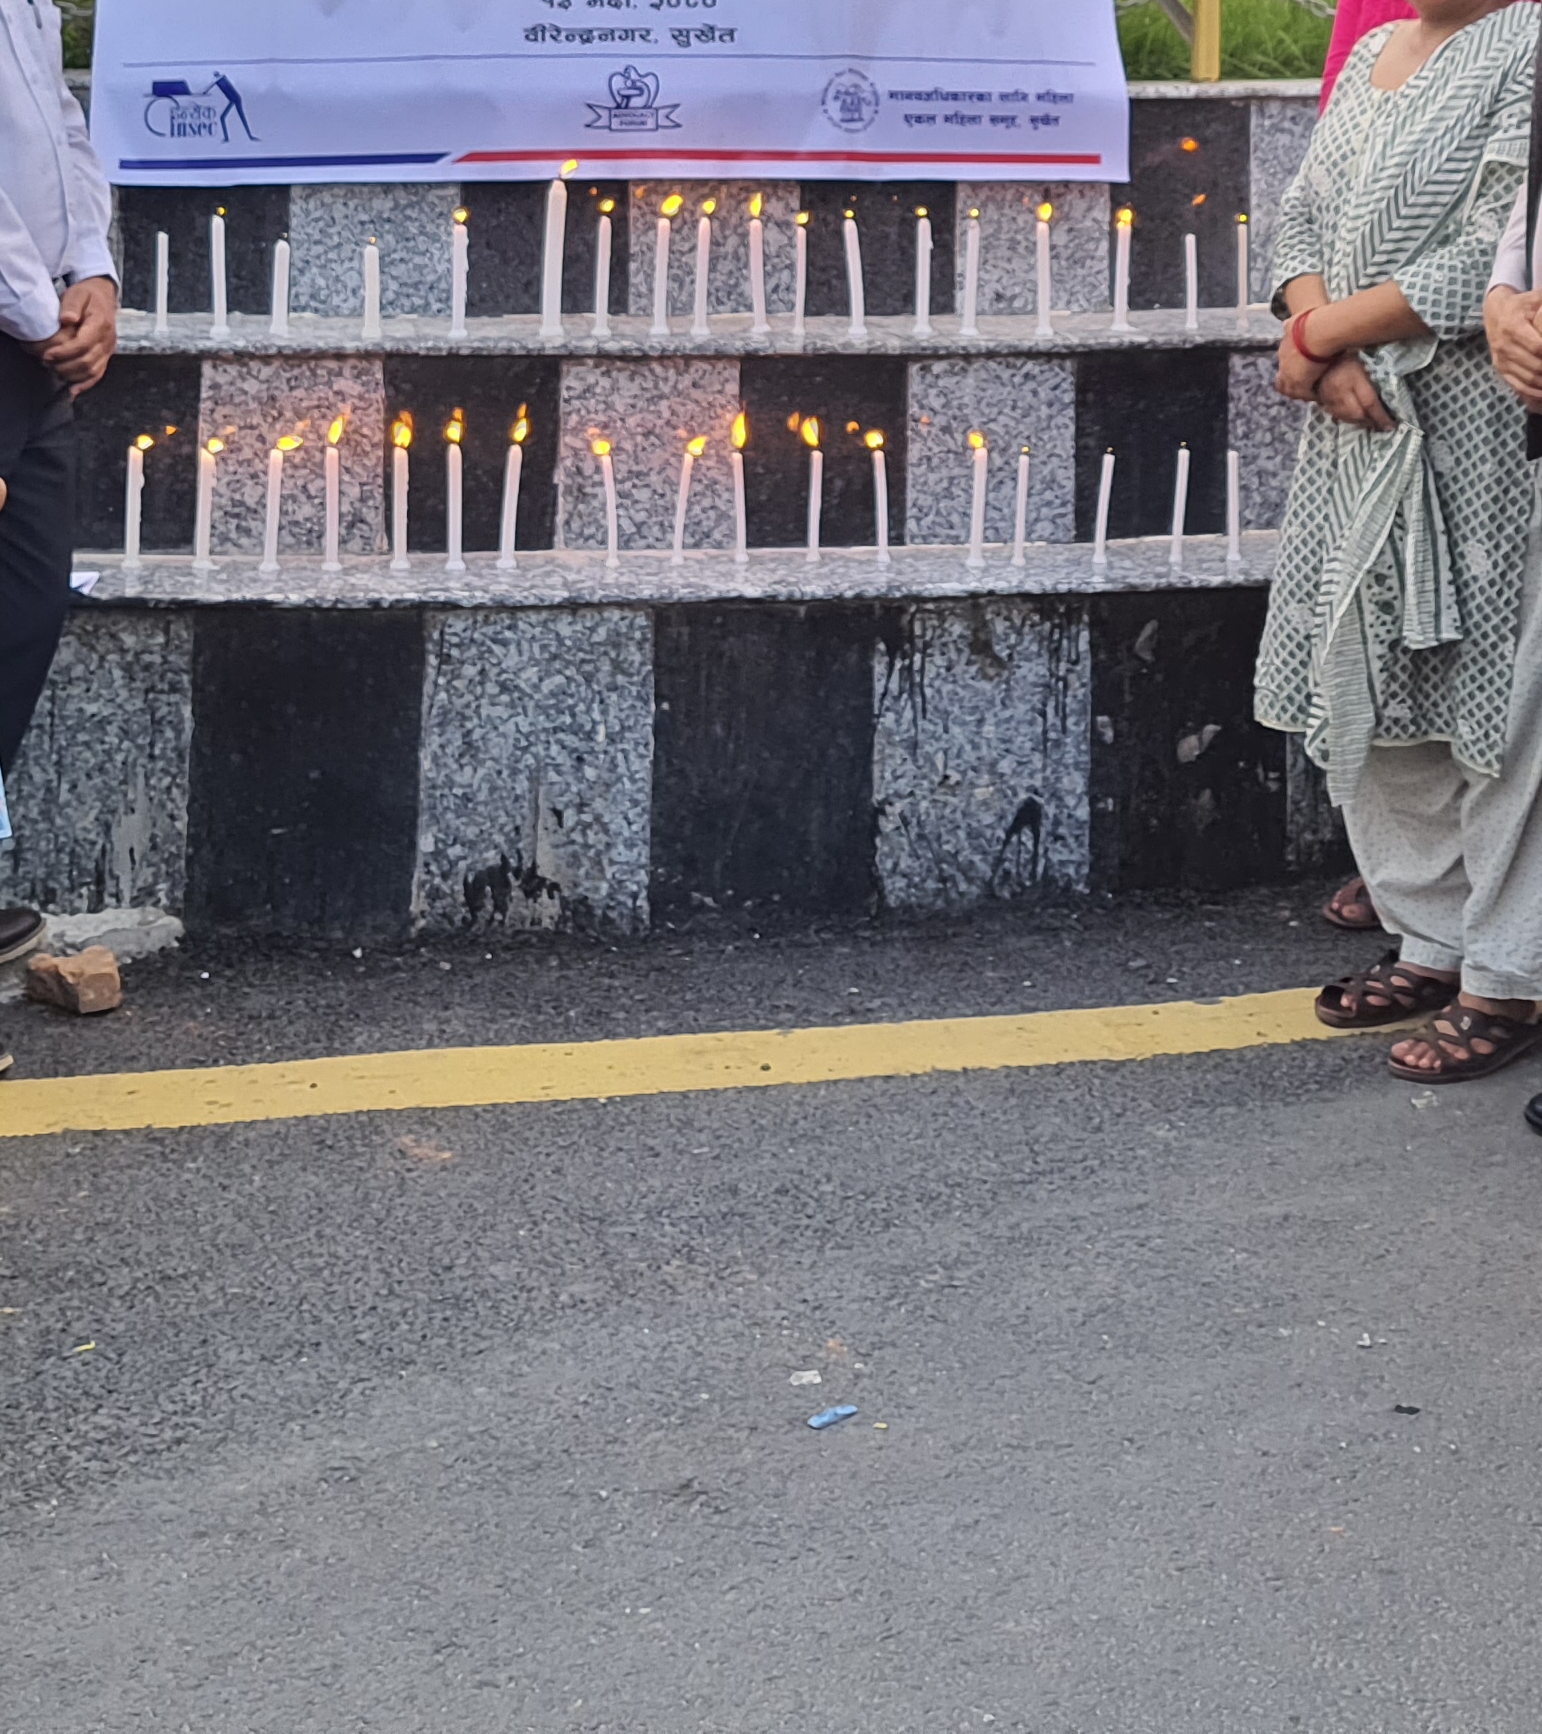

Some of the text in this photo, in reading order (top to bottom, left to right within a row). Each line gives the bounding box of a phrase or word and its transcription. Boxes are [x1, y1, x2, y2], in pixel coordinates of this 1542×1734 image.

[669, 22, 739, 48] सुर्खेत
[1035, 88, 1075, 104] महिला
[904, 113, 938, 129] एकल
[943, 110, 982, 126] महिला
[1029, 112, 1061, 130] सुर्खेत
